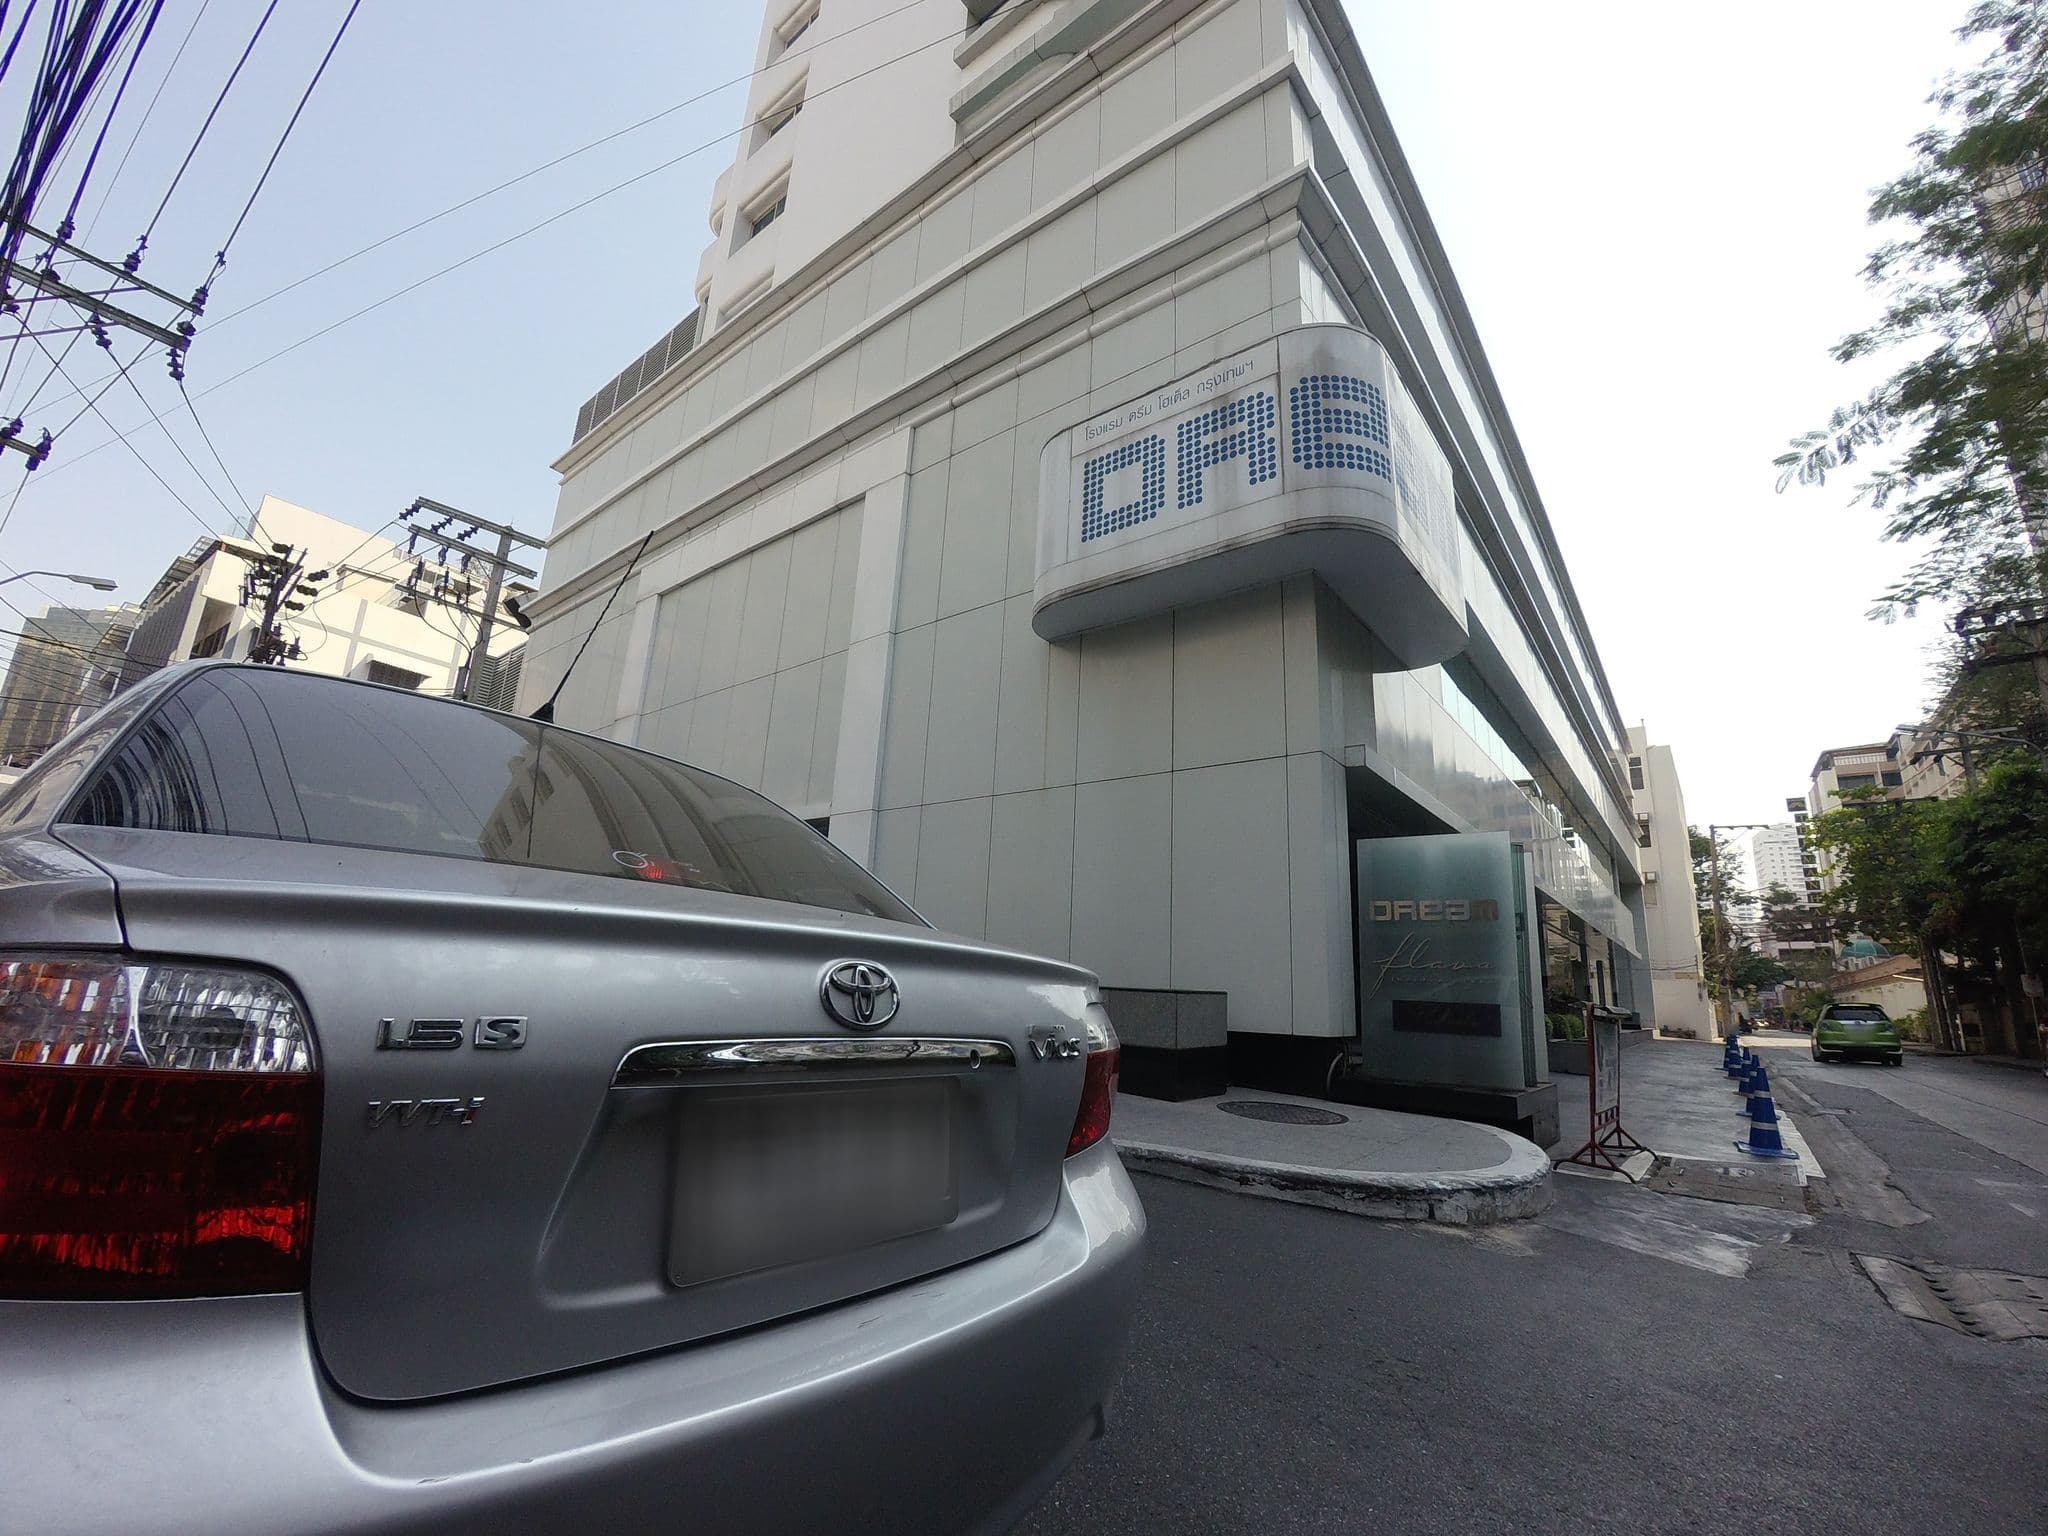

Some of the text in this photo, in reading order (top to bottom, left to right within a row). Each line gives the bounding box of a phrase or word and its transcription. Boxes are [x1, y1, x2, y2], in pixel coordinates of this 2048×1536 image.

[1084, 416, 1123, 441] โรงแรม
[480, 1017, 526, 1047] S
